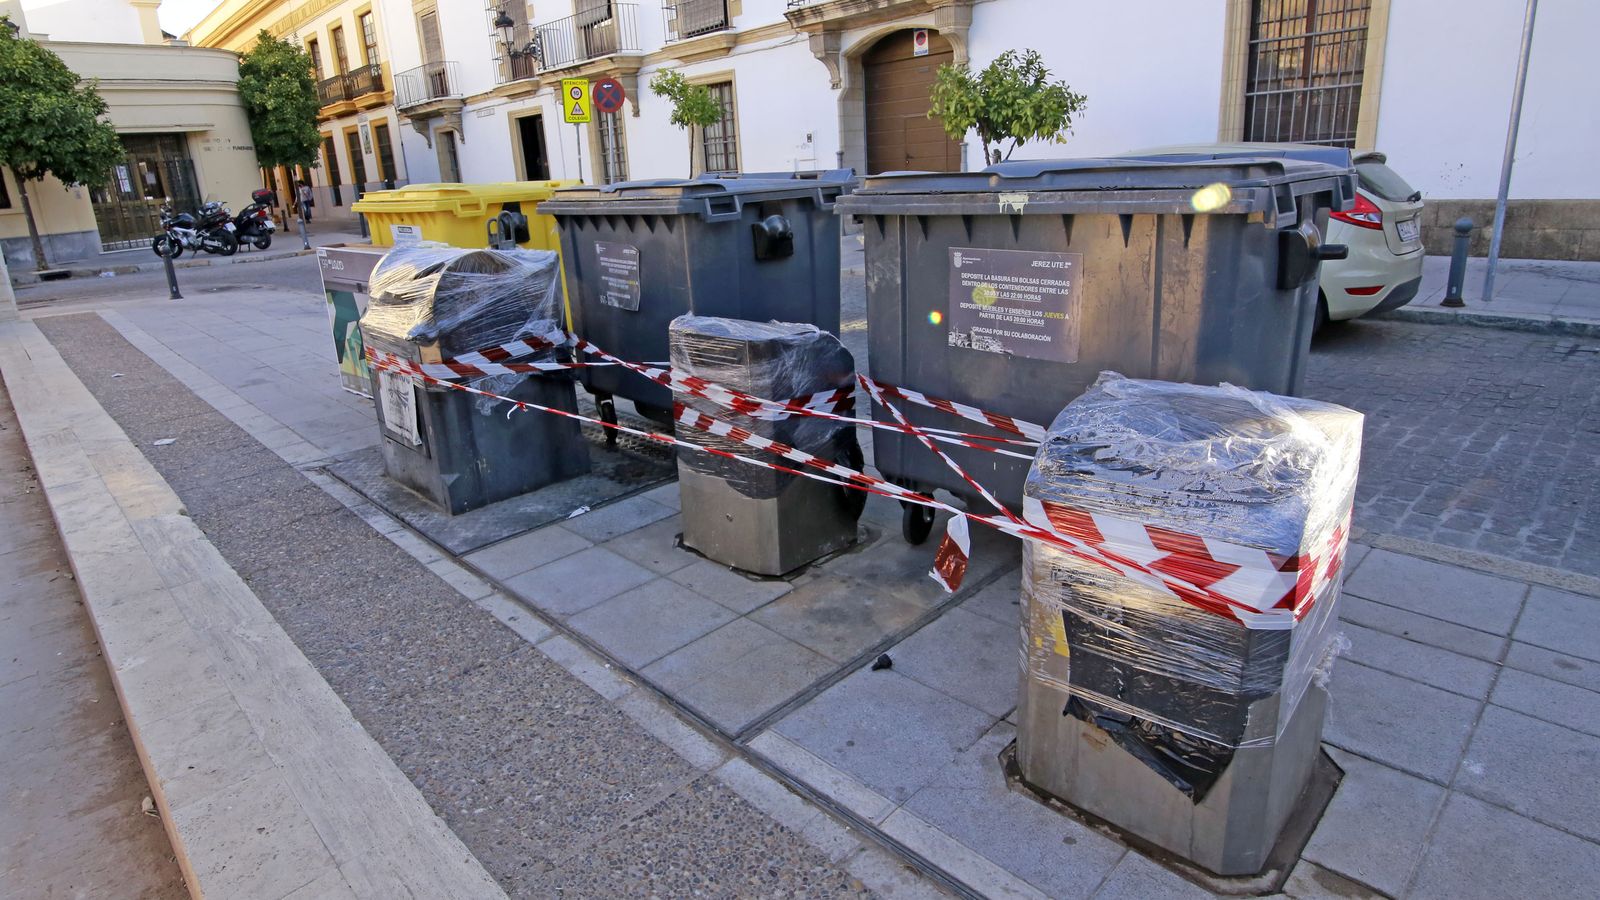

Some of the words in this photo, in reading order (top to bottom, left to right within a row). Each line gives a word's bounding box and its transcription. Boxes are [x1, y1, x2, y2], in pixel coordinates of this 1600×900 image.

[1040, 278, 1070, 286] CERRADAS
[998, 284, 1038, 293] CONTENEDORES
[982, 304, 1004, 312] MUEBLES
[1009, 307, 1031, 316] ENSERES
[972, 326, 992, 335] GRACIAS
[1011, 330, 1051, 342] COLABORACIÓN
